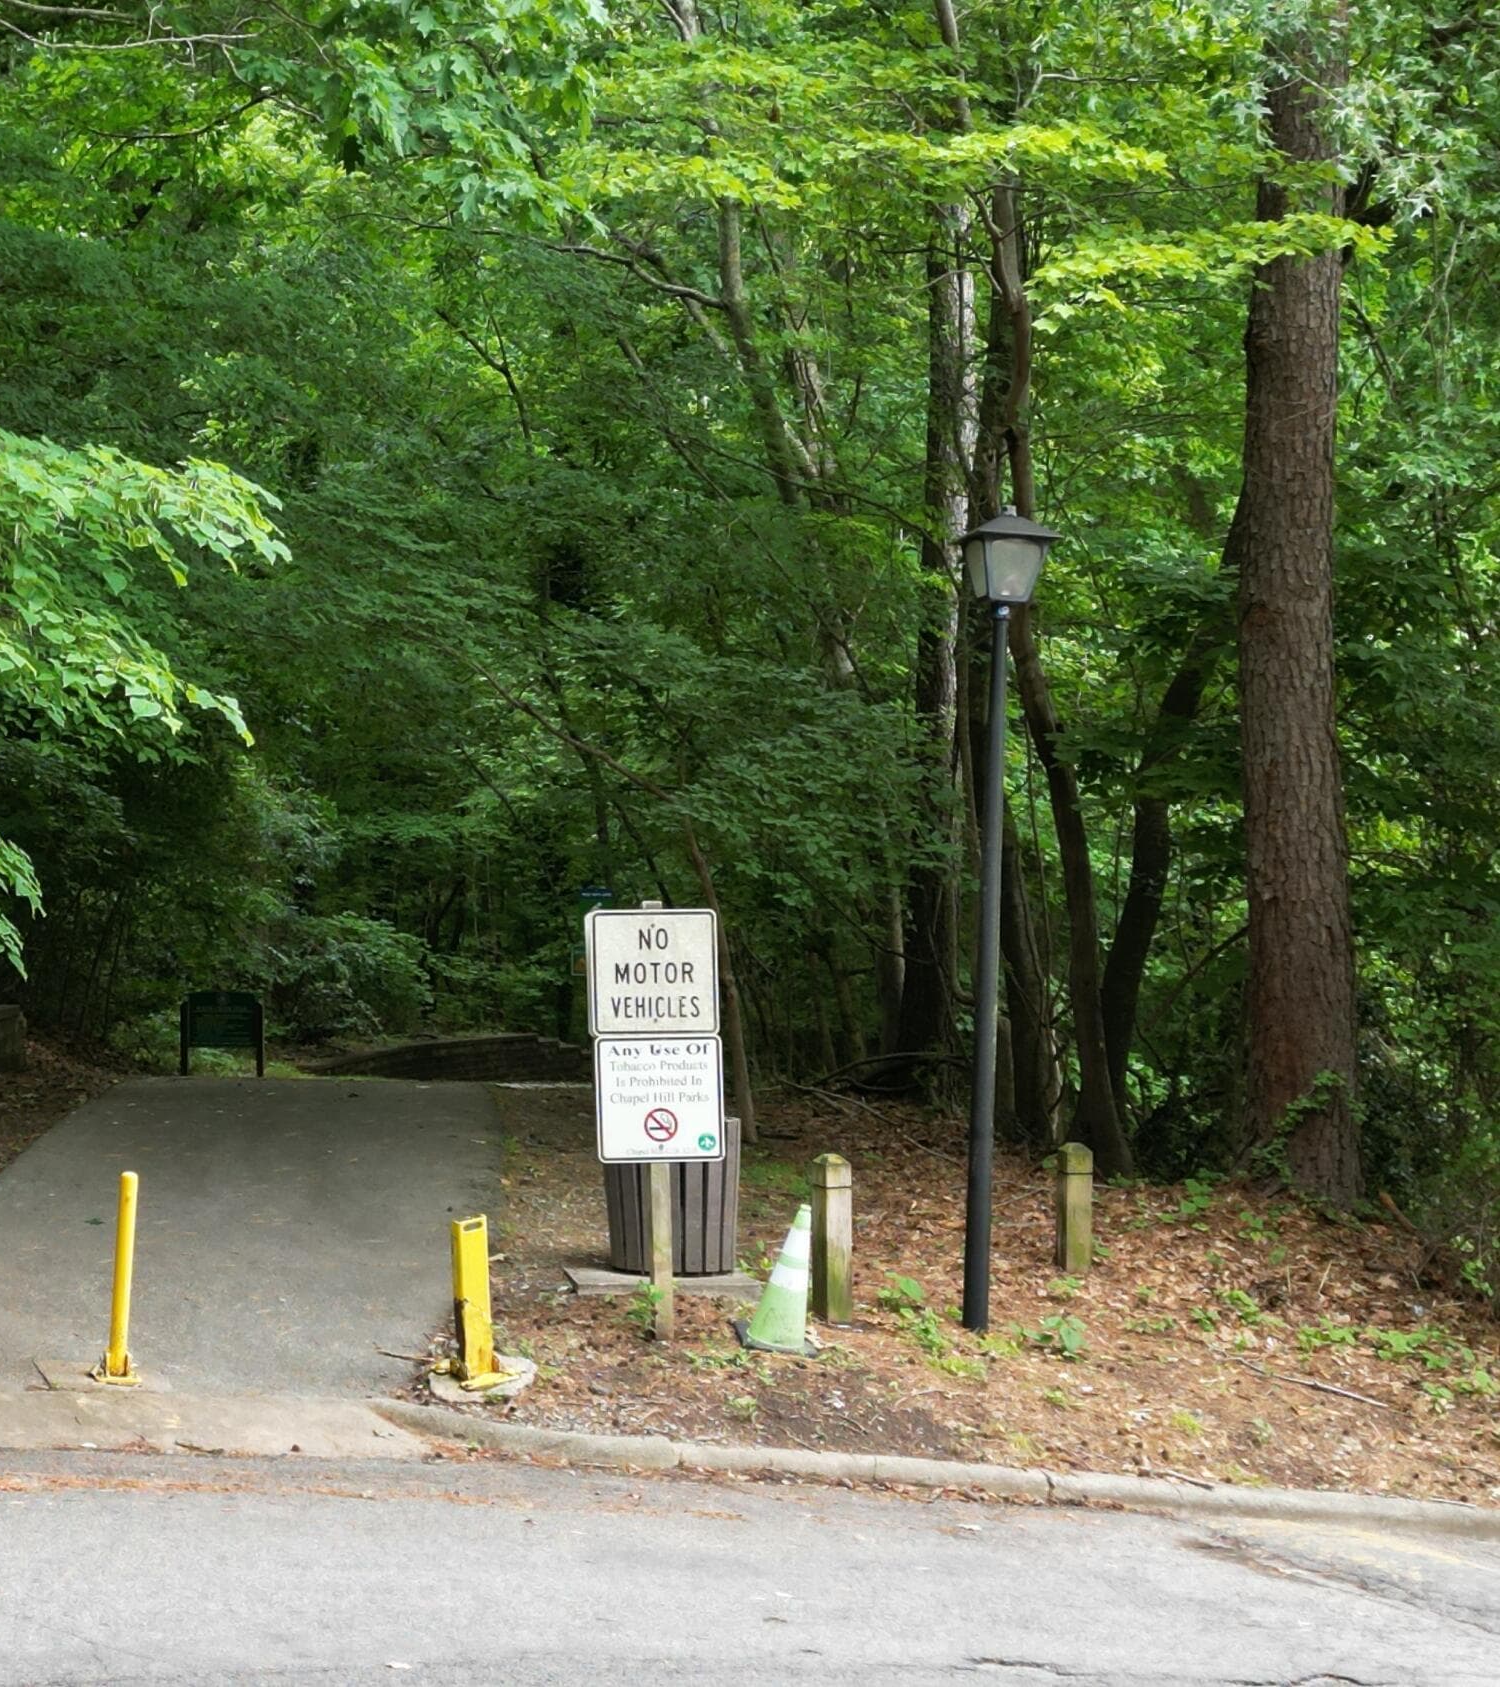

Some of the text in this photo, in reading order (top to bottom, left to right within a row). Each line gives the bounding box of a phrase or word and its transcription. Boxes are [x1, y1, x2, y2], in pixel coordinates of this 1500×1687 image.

[638, 928, 669, 950] NO
[614, 962, 695, 984] MOTOR
[610, 996, 701, 1019] VEHICLES
[607, 1042, 711, 1060] Any Use Of
[609, 1059, 709, 1073] Tobacco Products
[615, 1075, 703, 1088] Is Prohibited In
[609, 1091, 710, 1106] Chapel Hill Parks
